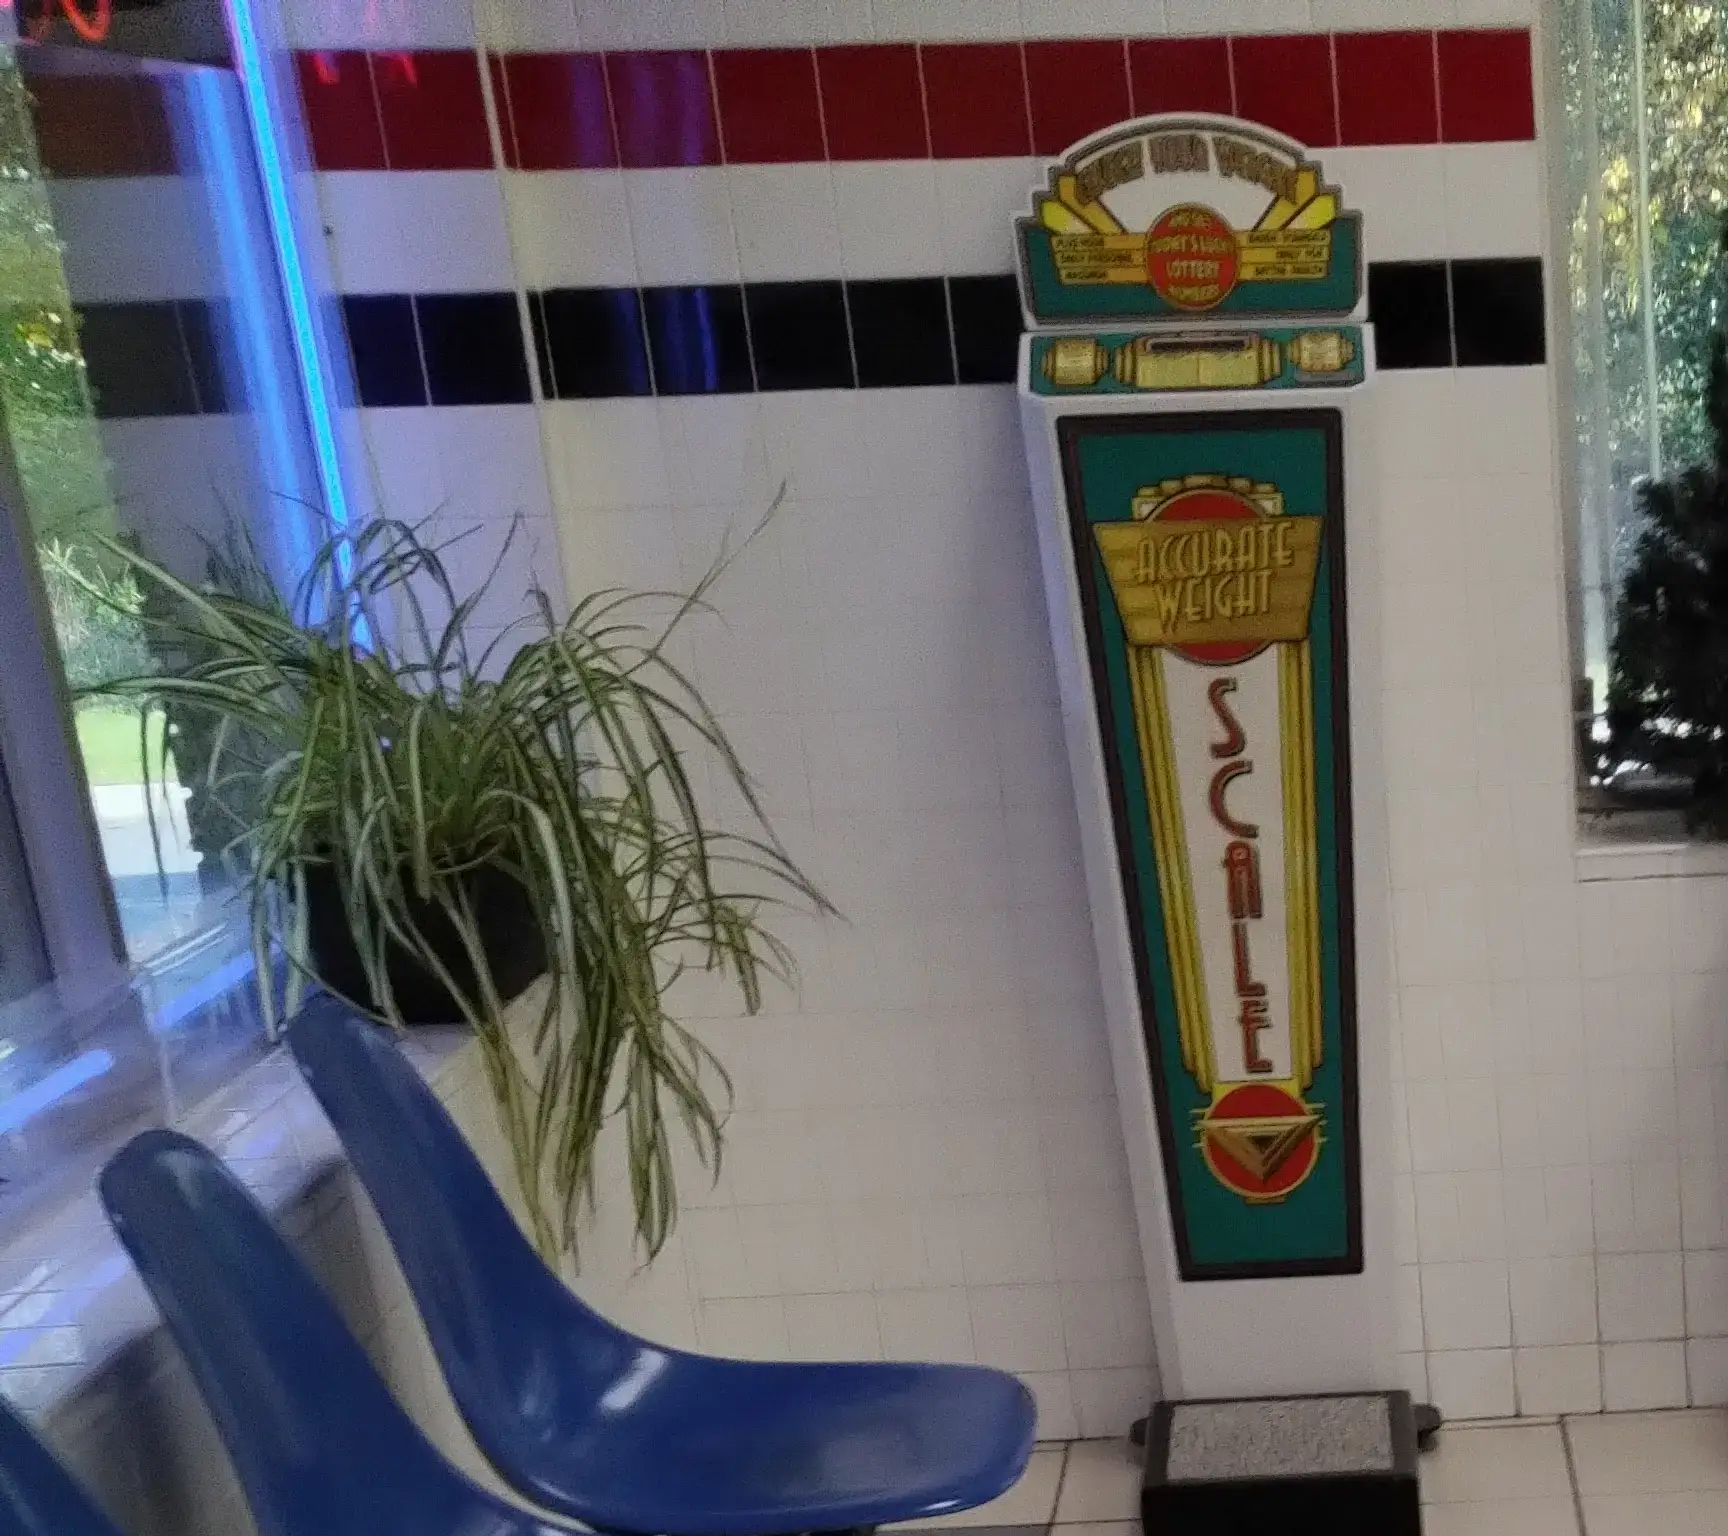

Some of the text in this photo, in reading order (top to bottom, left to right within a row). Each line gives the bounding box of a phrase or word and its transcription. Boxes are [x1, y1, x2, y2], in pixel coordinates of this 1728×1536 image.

[1134, 521, 1296, 584] ACCURATE
[1155, 571, 1273, 634] WEIGHT
[1207, 677, 1273, 1074] SCALE
